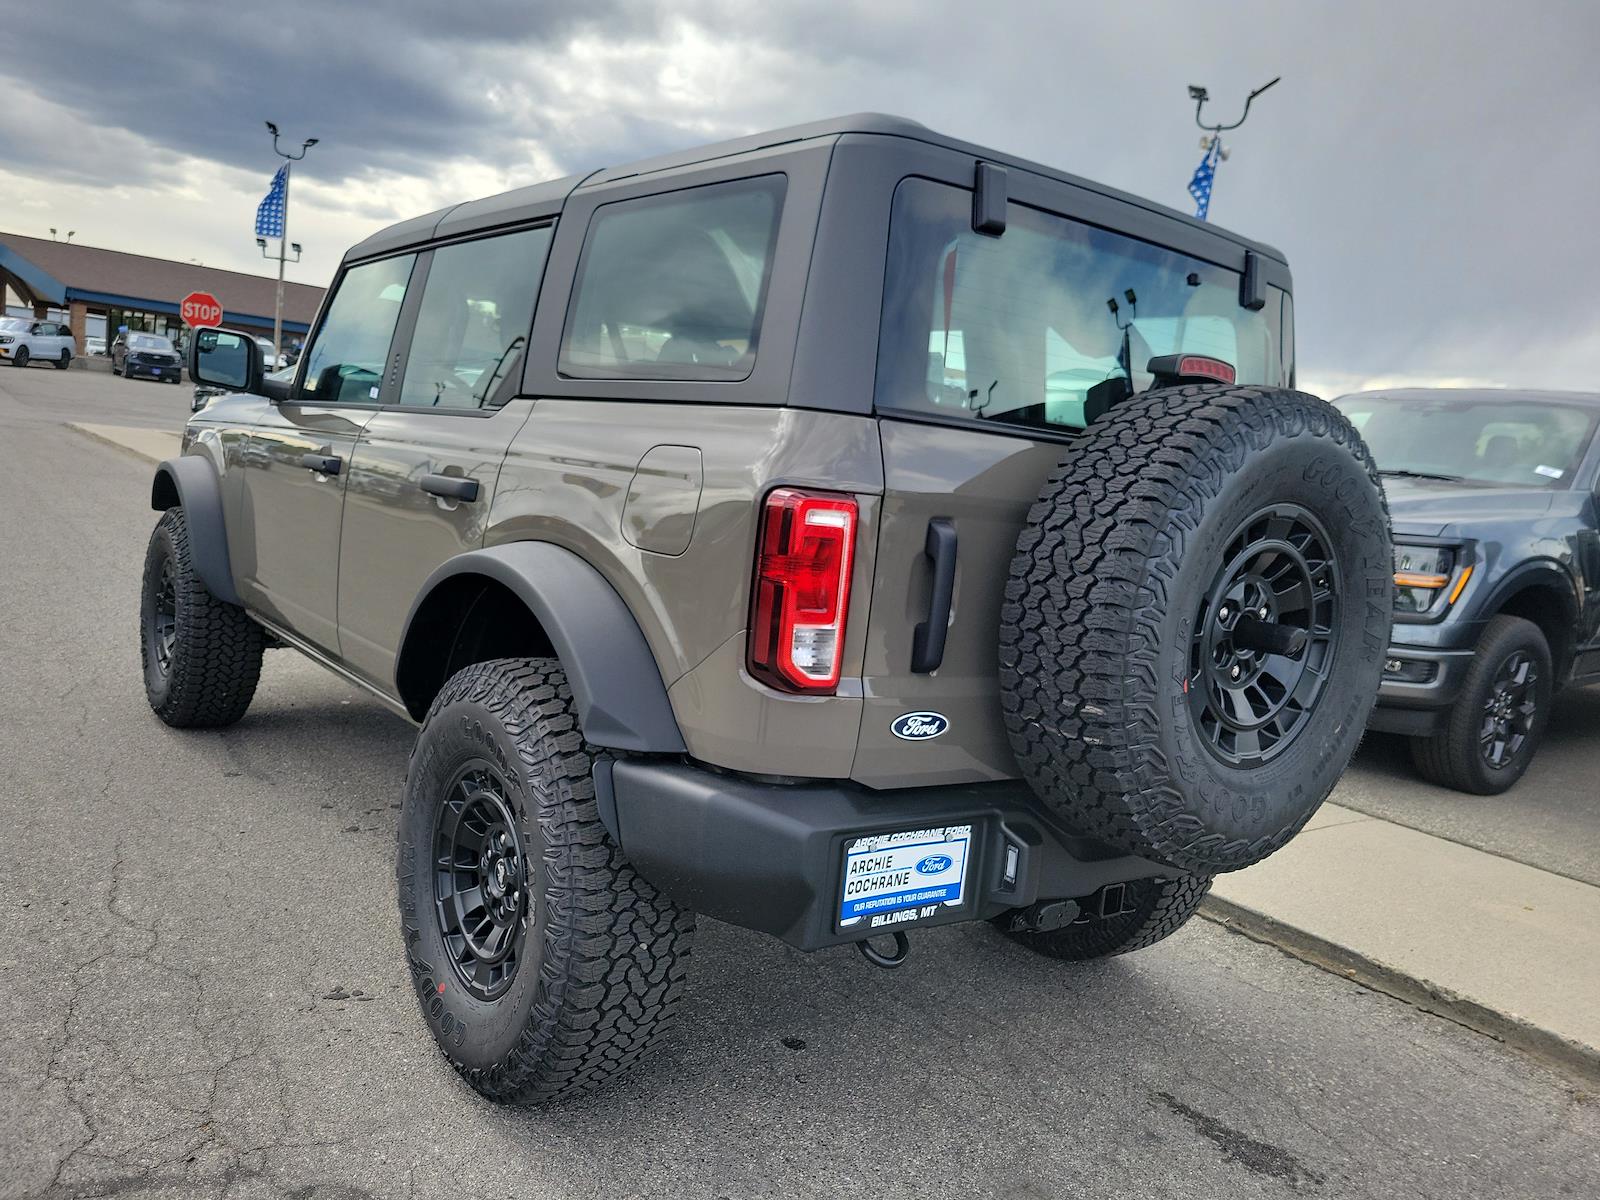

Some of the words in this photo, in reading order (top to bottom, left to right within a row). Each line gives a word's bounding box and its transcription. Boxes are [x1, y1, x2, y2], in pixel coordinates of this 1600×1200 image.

[183, 302, 220, 321] STOP
[902, 716, 940, 735] Ford
[853, 835, 890, 848] ARCHIE
[890, 828, 944, 843] COCHRANE
[944, 825, 972, 837] FORD
[850, 855, 894, 875] ARCHIE
[921, 856, 946, 873] Ford
[847, 872, 910, 895] COCHRANE
[853, 902, 865, 912] OUR
[865, 897, 896, 910] REPUTATION
[896, 895, 902, 904] IS
[902, 893, 917, 903] YOUR
[917, 888, 947, 900] GUARANTEE
[871, 909, 918, 927] BILLINGS,
[920, 906, 937, 918] MT
